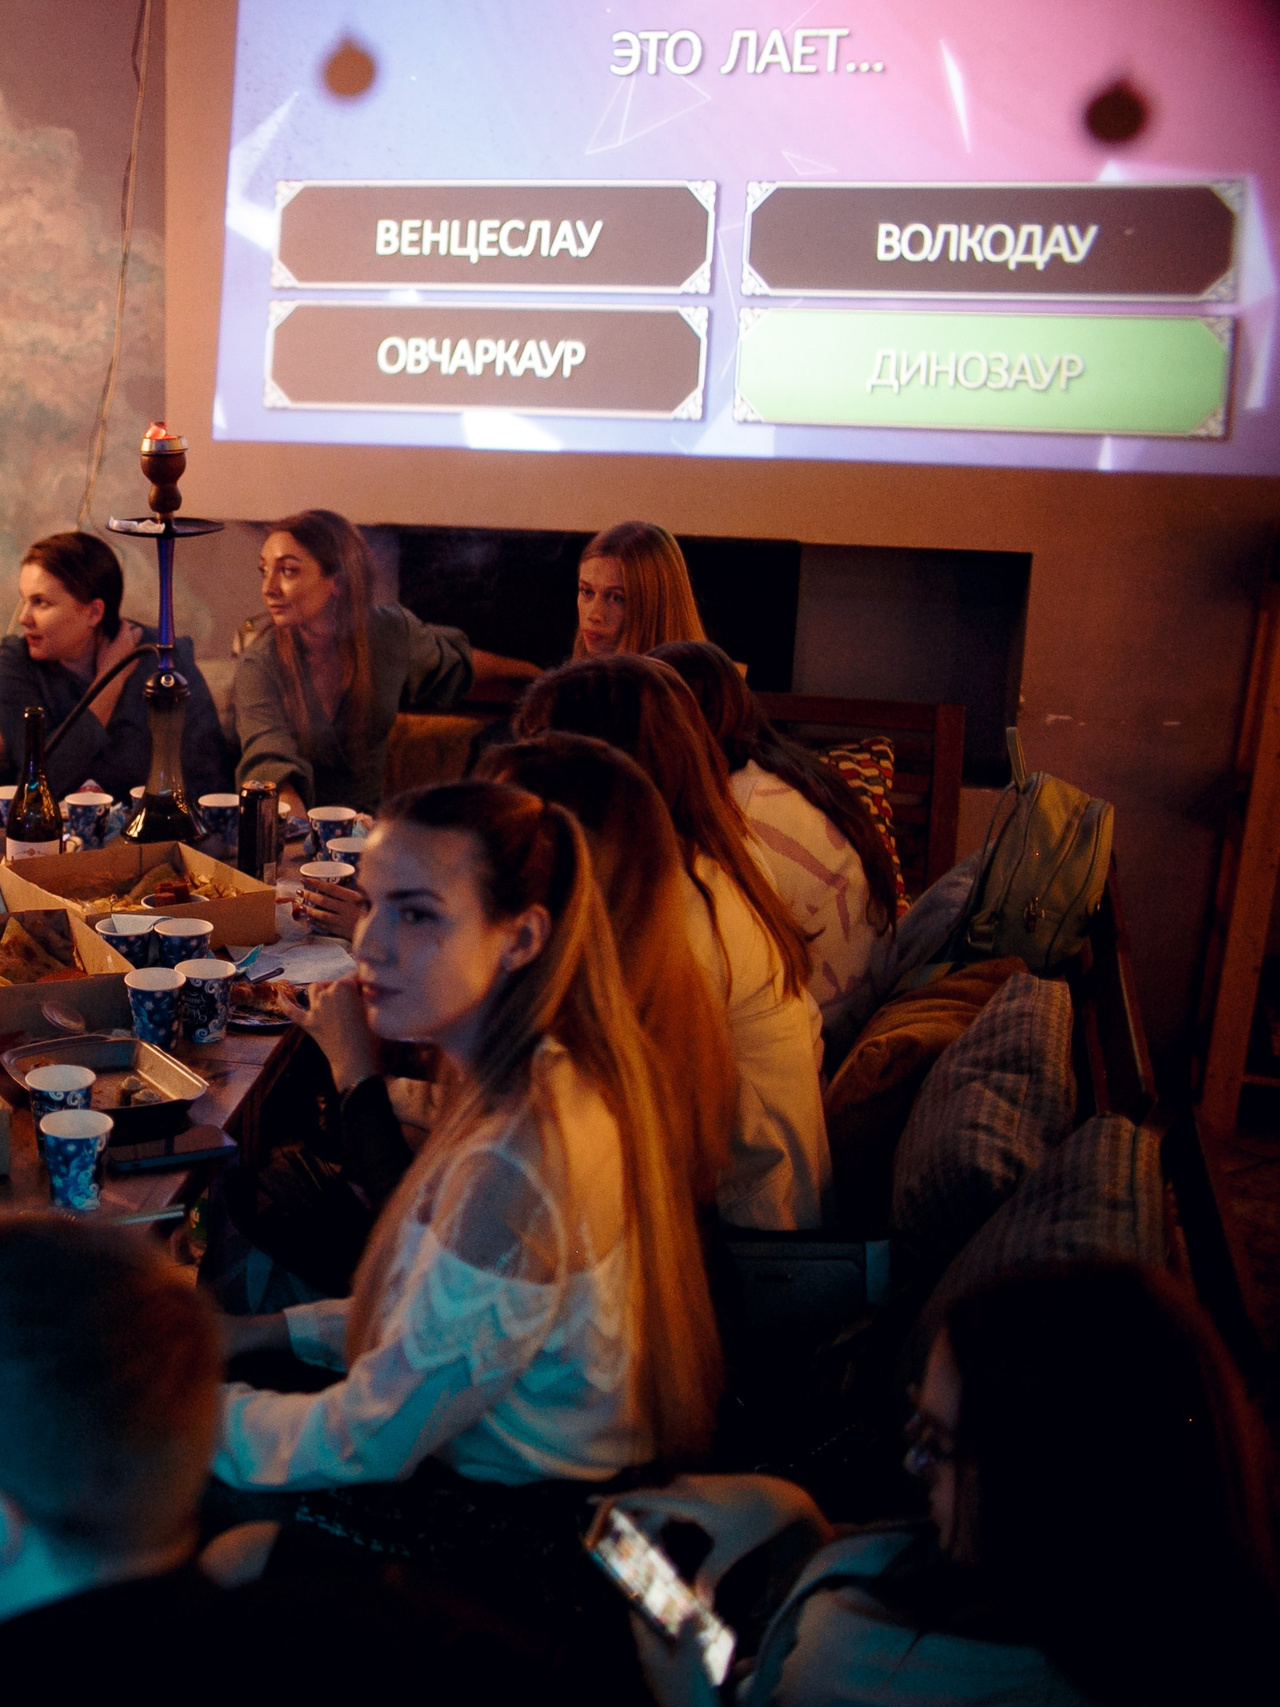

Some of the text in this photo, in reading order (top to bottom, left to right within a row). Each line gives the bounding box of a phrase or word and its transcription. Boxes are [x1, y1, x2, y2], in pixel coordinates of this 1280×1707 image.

[610, 28, 886, 76] ЭТО ЛАЕТ...
[375, 219, 604, 264] ВЕНЦЕСЛАУ
[876, 222, 1100, 271] ВОЛКОДАУ
[376, 336, 587, 378] ОВЧАРКАУР
[865, 348, 1085, 394] ДИНОЗАУР
